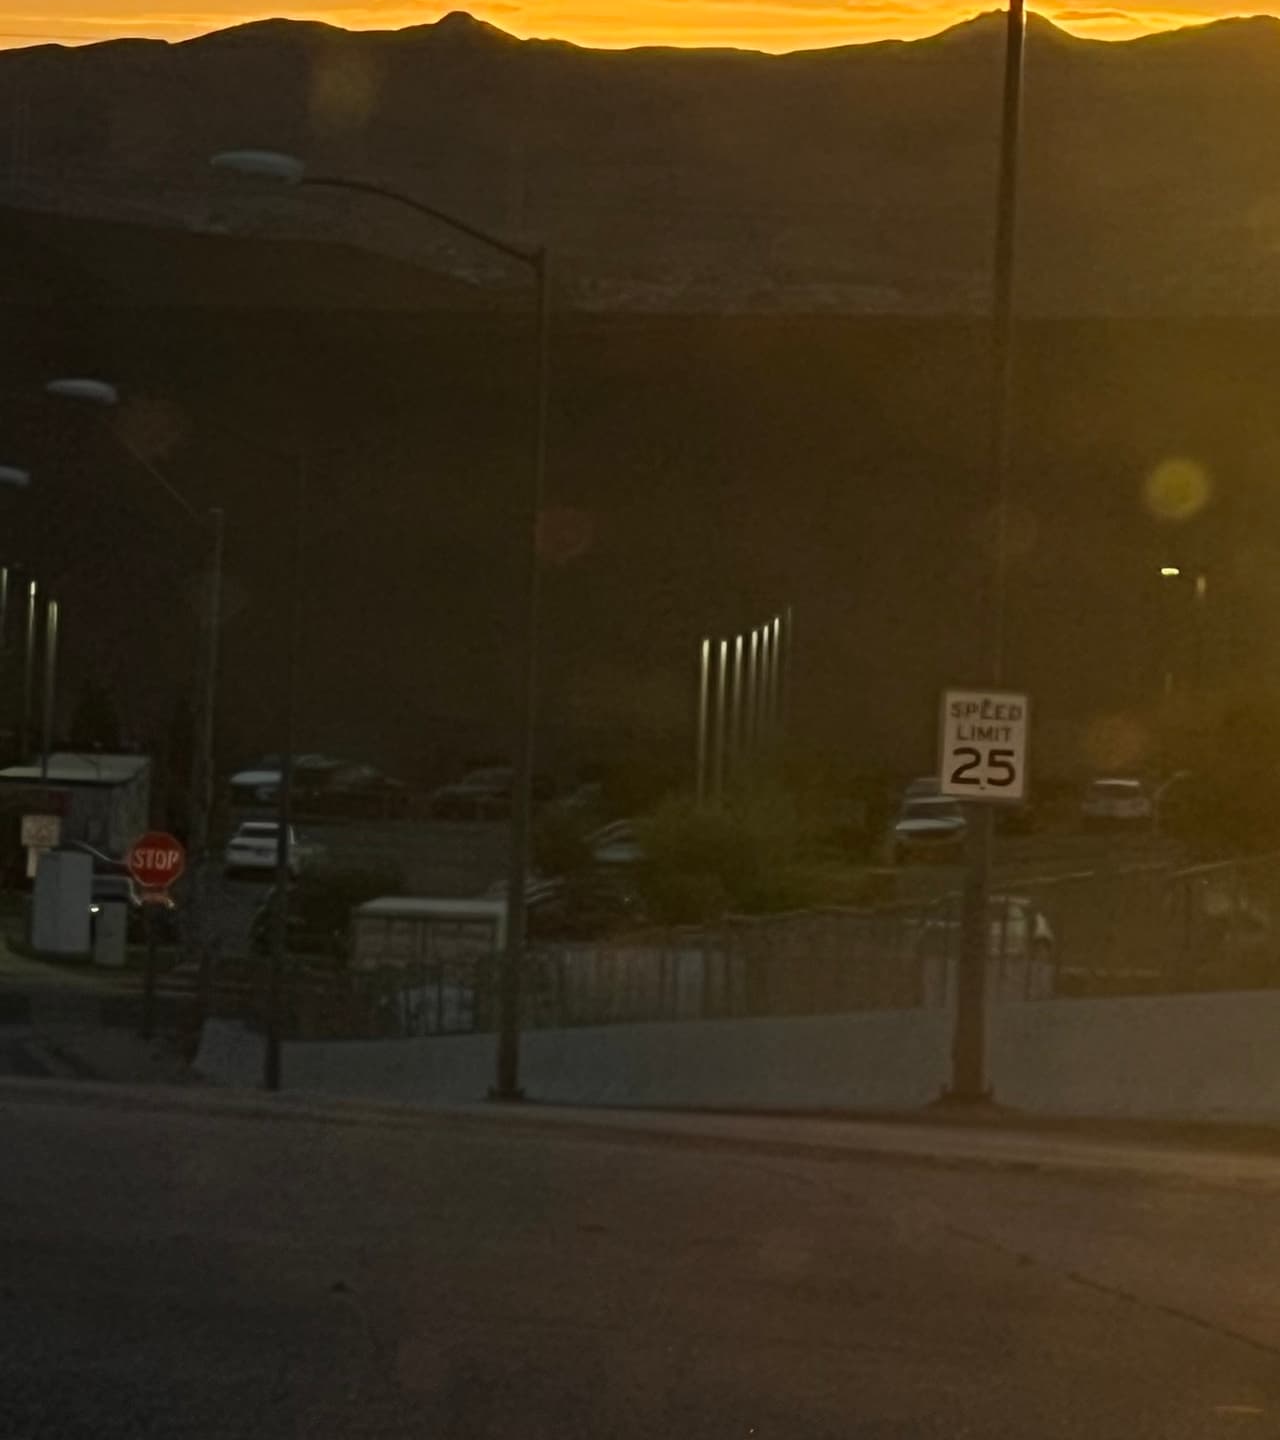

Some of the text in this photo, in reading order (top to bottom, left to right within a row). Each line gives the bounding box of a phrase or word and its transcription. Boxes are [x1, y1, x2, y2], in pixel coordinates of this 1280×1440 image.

[950, 701, 1022, 721] SPEED
[957, 724, 1011, 742] LIMIT
[950, 747, 1016, 787] 25
[132, 848, 180, 870] STOP
